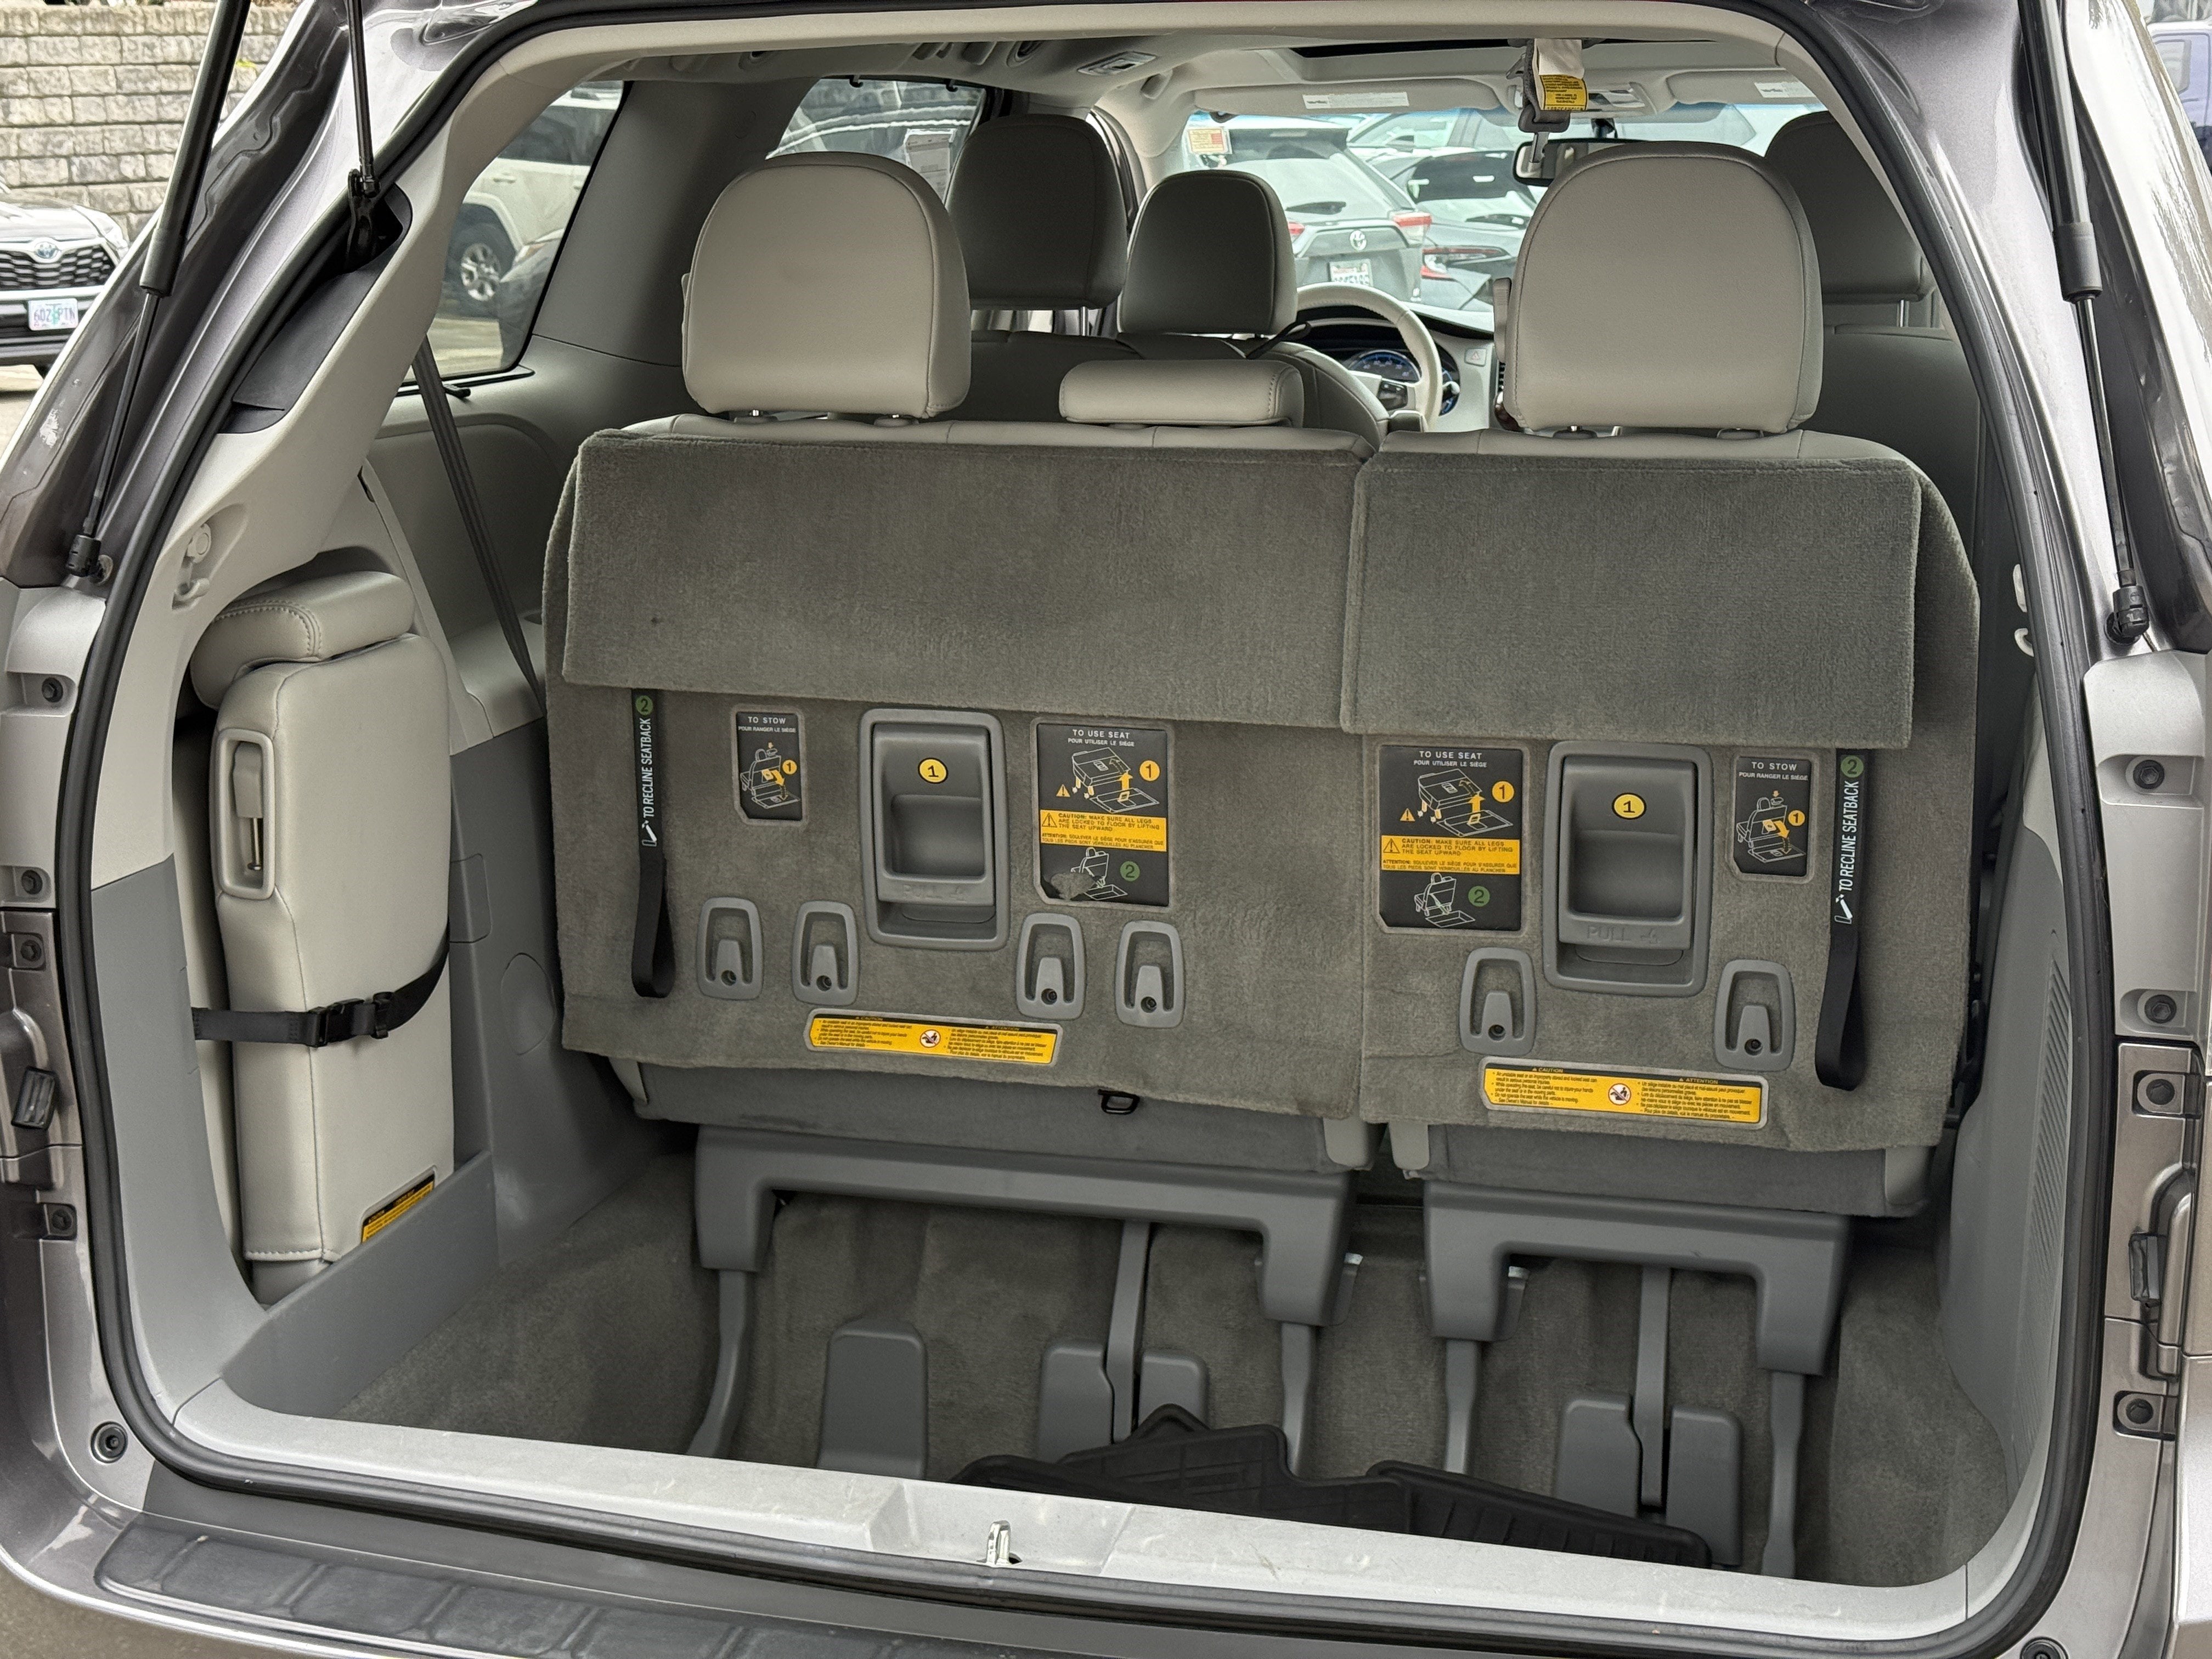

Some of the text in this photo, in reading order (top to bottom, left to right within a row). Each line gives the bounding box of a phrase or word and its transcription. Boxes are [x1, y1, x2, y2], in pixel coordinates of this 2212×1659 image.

[640, 698, 649, 712] 2
[1108, 731, 1130, 739] SEAT
[640, 718, 654, 818] TO RECLINE SEATBACK
[927, 765, 939, 778] 1
[1751, 761, 1797, 771] TO STOW
[1847, 759, 1858, 775] 2
[1623, 800, 1635, 814] 1
[1839, 780, 1859, 891] TO RECLINE SEATBACK
[1125, 865, 1135, 878] 2
[1474, 889, 1485, 904] 2
[1587, 926, 1631, 941] PULL
